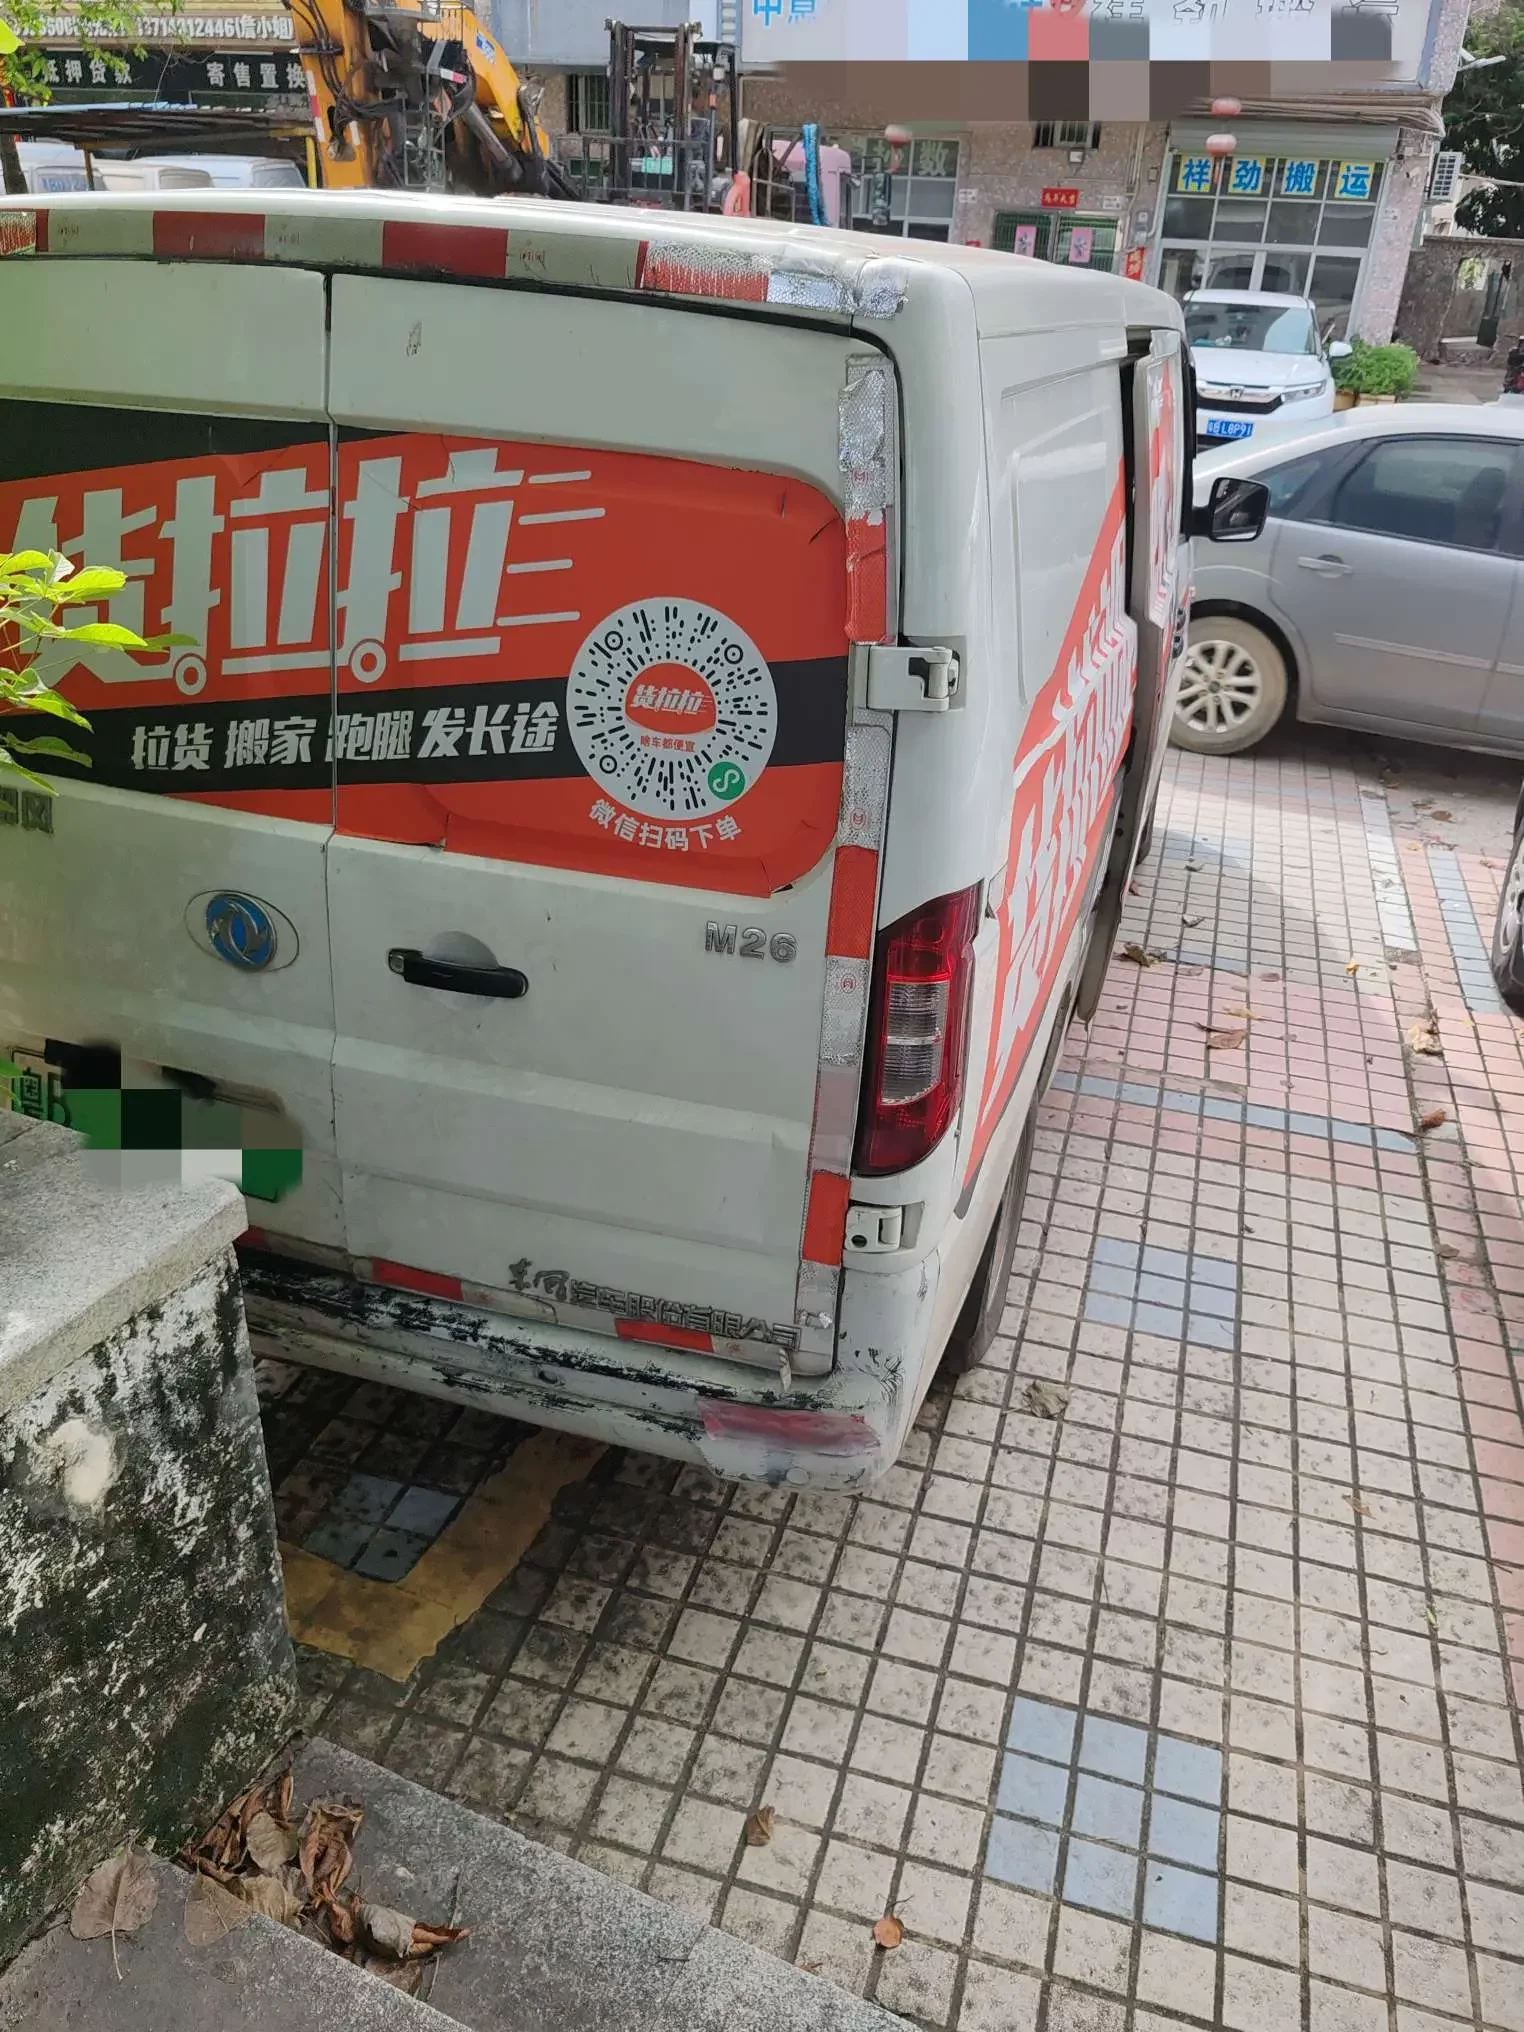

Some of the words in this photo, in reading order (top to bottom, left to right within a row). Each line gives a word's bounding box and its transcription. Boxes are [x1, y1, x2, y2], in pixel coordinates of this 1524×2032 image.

[206, 61, 307, 88] 寄售置换
[1182, 158, 1371, 197] 祥劲搬运
[10, 447, 524, 696] 货拉拉
[630, 684, 705, 716] 货拉拉
[131, 722, 214, 771] 拉货
[223, 715, 317, 769] 搬家
[326, 708, 417, 763] 跑腿
[418, 701, 560, 760] 发长途
[640, 735, 697, 753] 啥车都便宜
[588, 798, 743, 852] 微信扫码下单
[704, 920, 800, 964] M26
